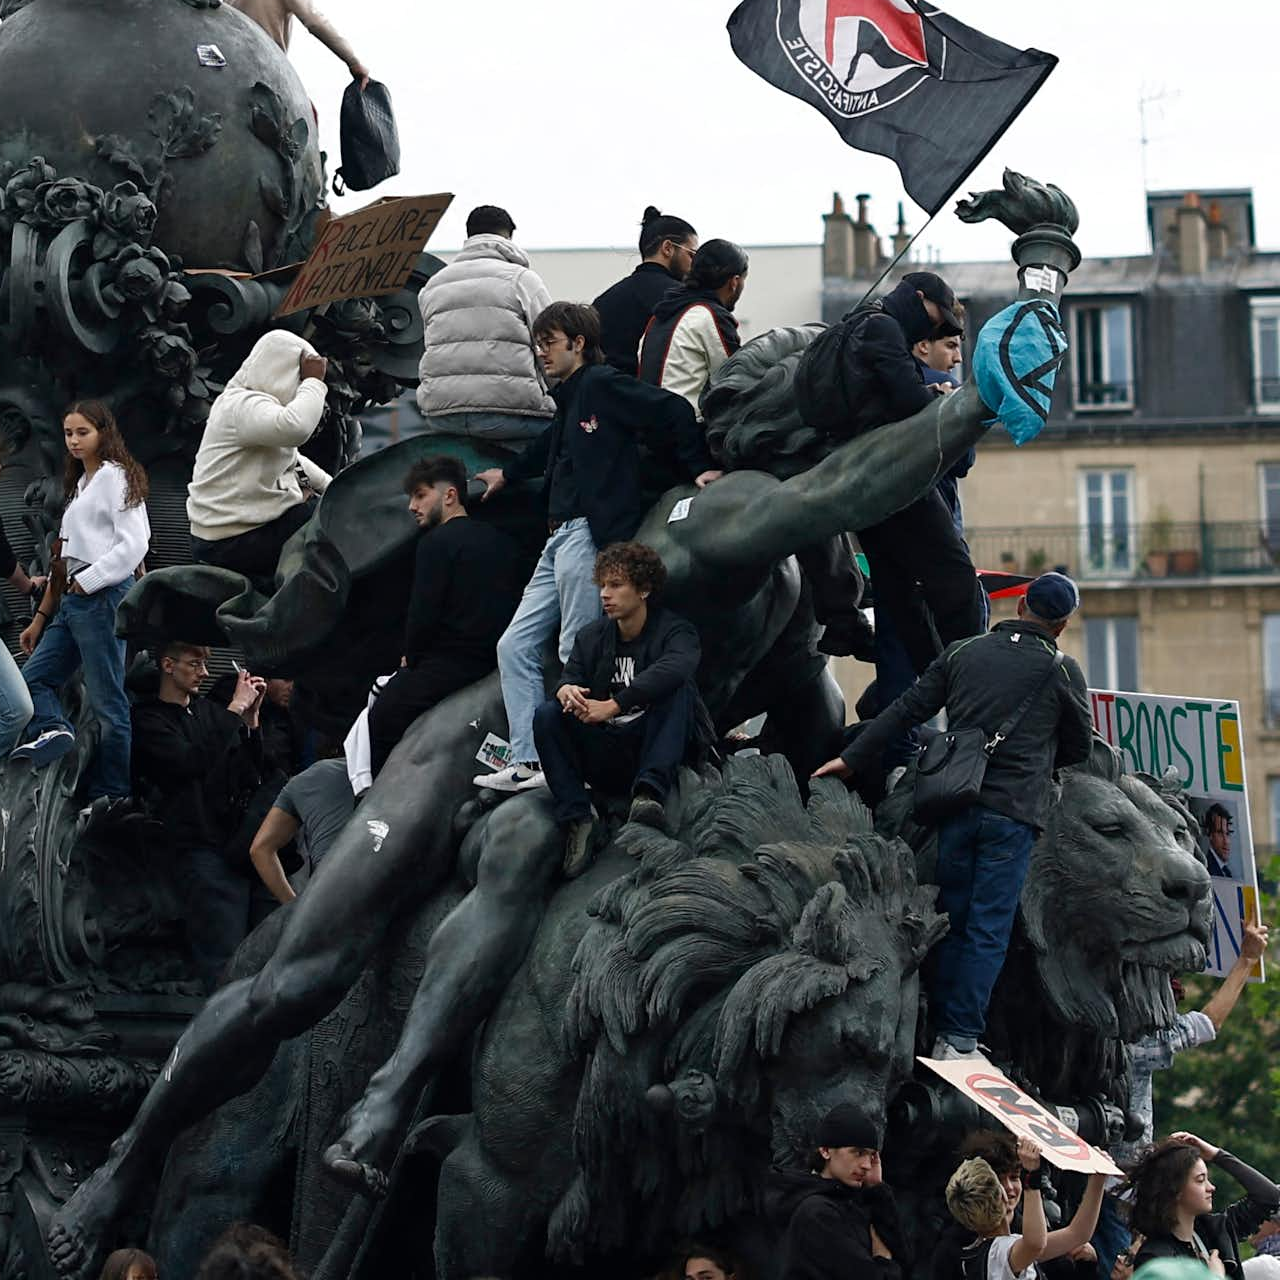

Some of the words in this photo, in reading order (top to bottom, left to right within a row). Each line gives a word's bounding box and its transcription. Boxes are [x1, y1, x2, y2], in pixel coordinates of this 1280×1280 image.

[310, 208, 441, 265] RACLURE
[284, 251, 421, 312] NATIONALE
[1115, 696, 1244, 792] BOOSTÉ
[979, 1087, 1081, 1147] RN
